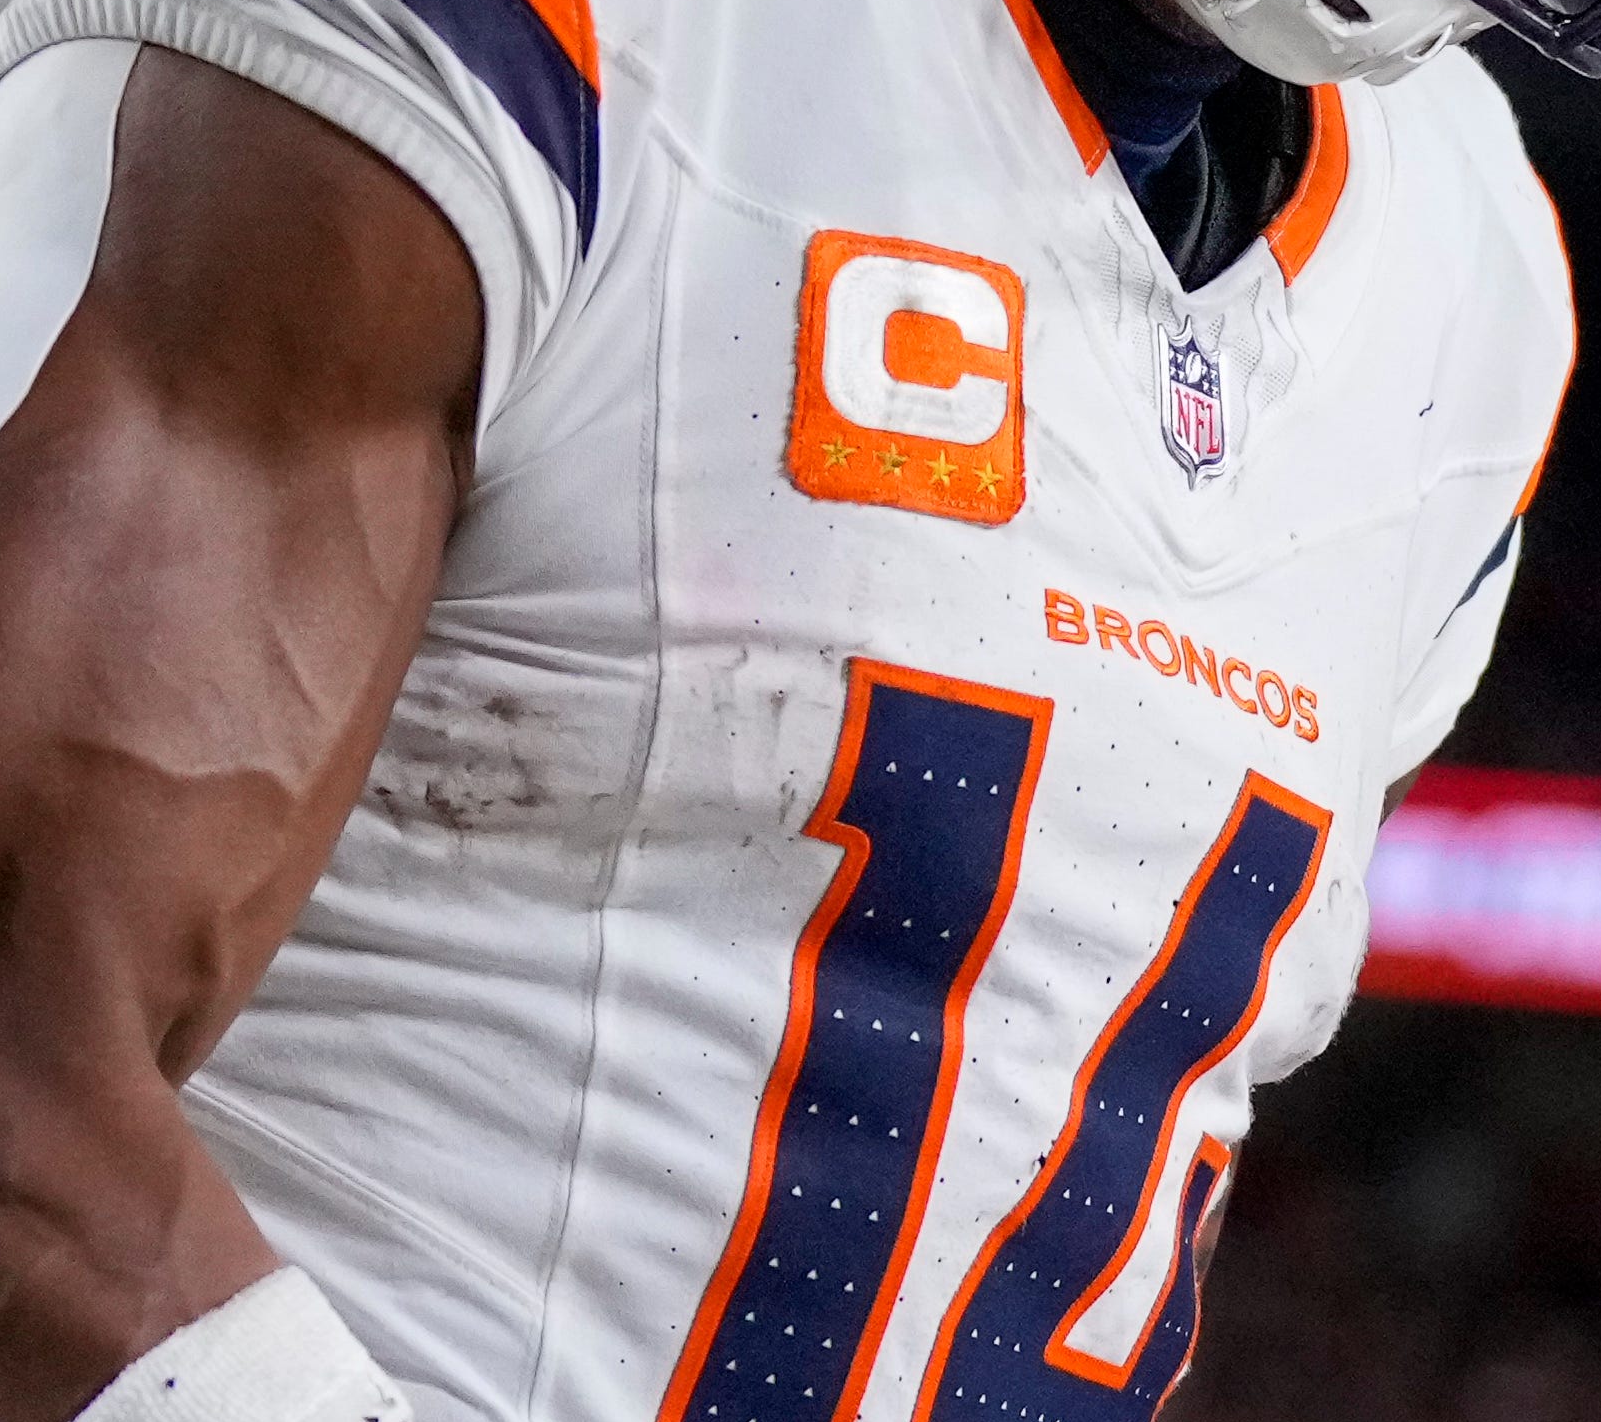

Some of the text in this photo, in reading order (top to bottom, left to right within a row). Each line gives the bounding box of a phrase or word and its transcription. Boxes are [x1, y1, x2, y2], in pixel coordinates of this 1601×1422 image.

[822, 254, 1010, 446] C
[1175, 386, 1221, 457] NFL
[1043, 588, 1319, 743] BRONCOS
